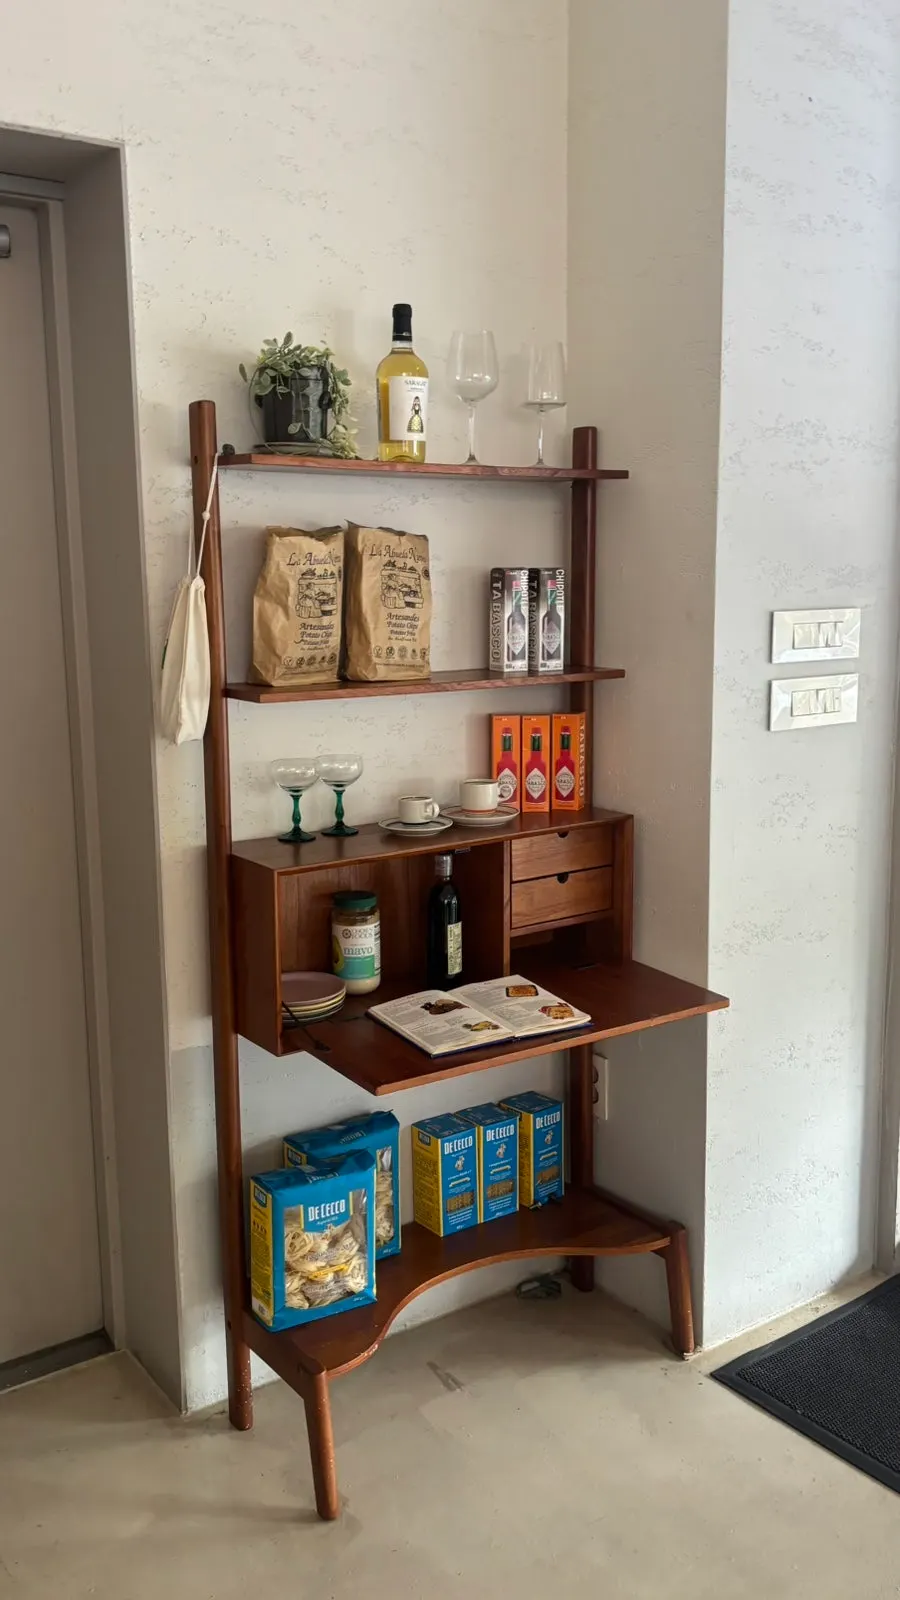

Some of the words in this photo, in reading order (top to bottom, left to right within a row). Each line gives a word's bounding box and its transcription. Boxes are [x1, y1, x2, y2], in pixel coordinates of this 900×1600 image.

[492, 581, 502, 661] TABASCO
[344, 947, 373, 957] mayo
[535, 1116, 544, 1129] DE
[544, 1111, 560, 1126] CECCO
[486, 1129, 495, 1142] DE
[495, 1124, 515, 1140] CECCO
[444, 1142, 454, 1155] DE
[454, 1135, 473, 1151] CECCO
[308, 1206, 320, 1221] DE
[321, 1199, 345, 1219] CECCO
